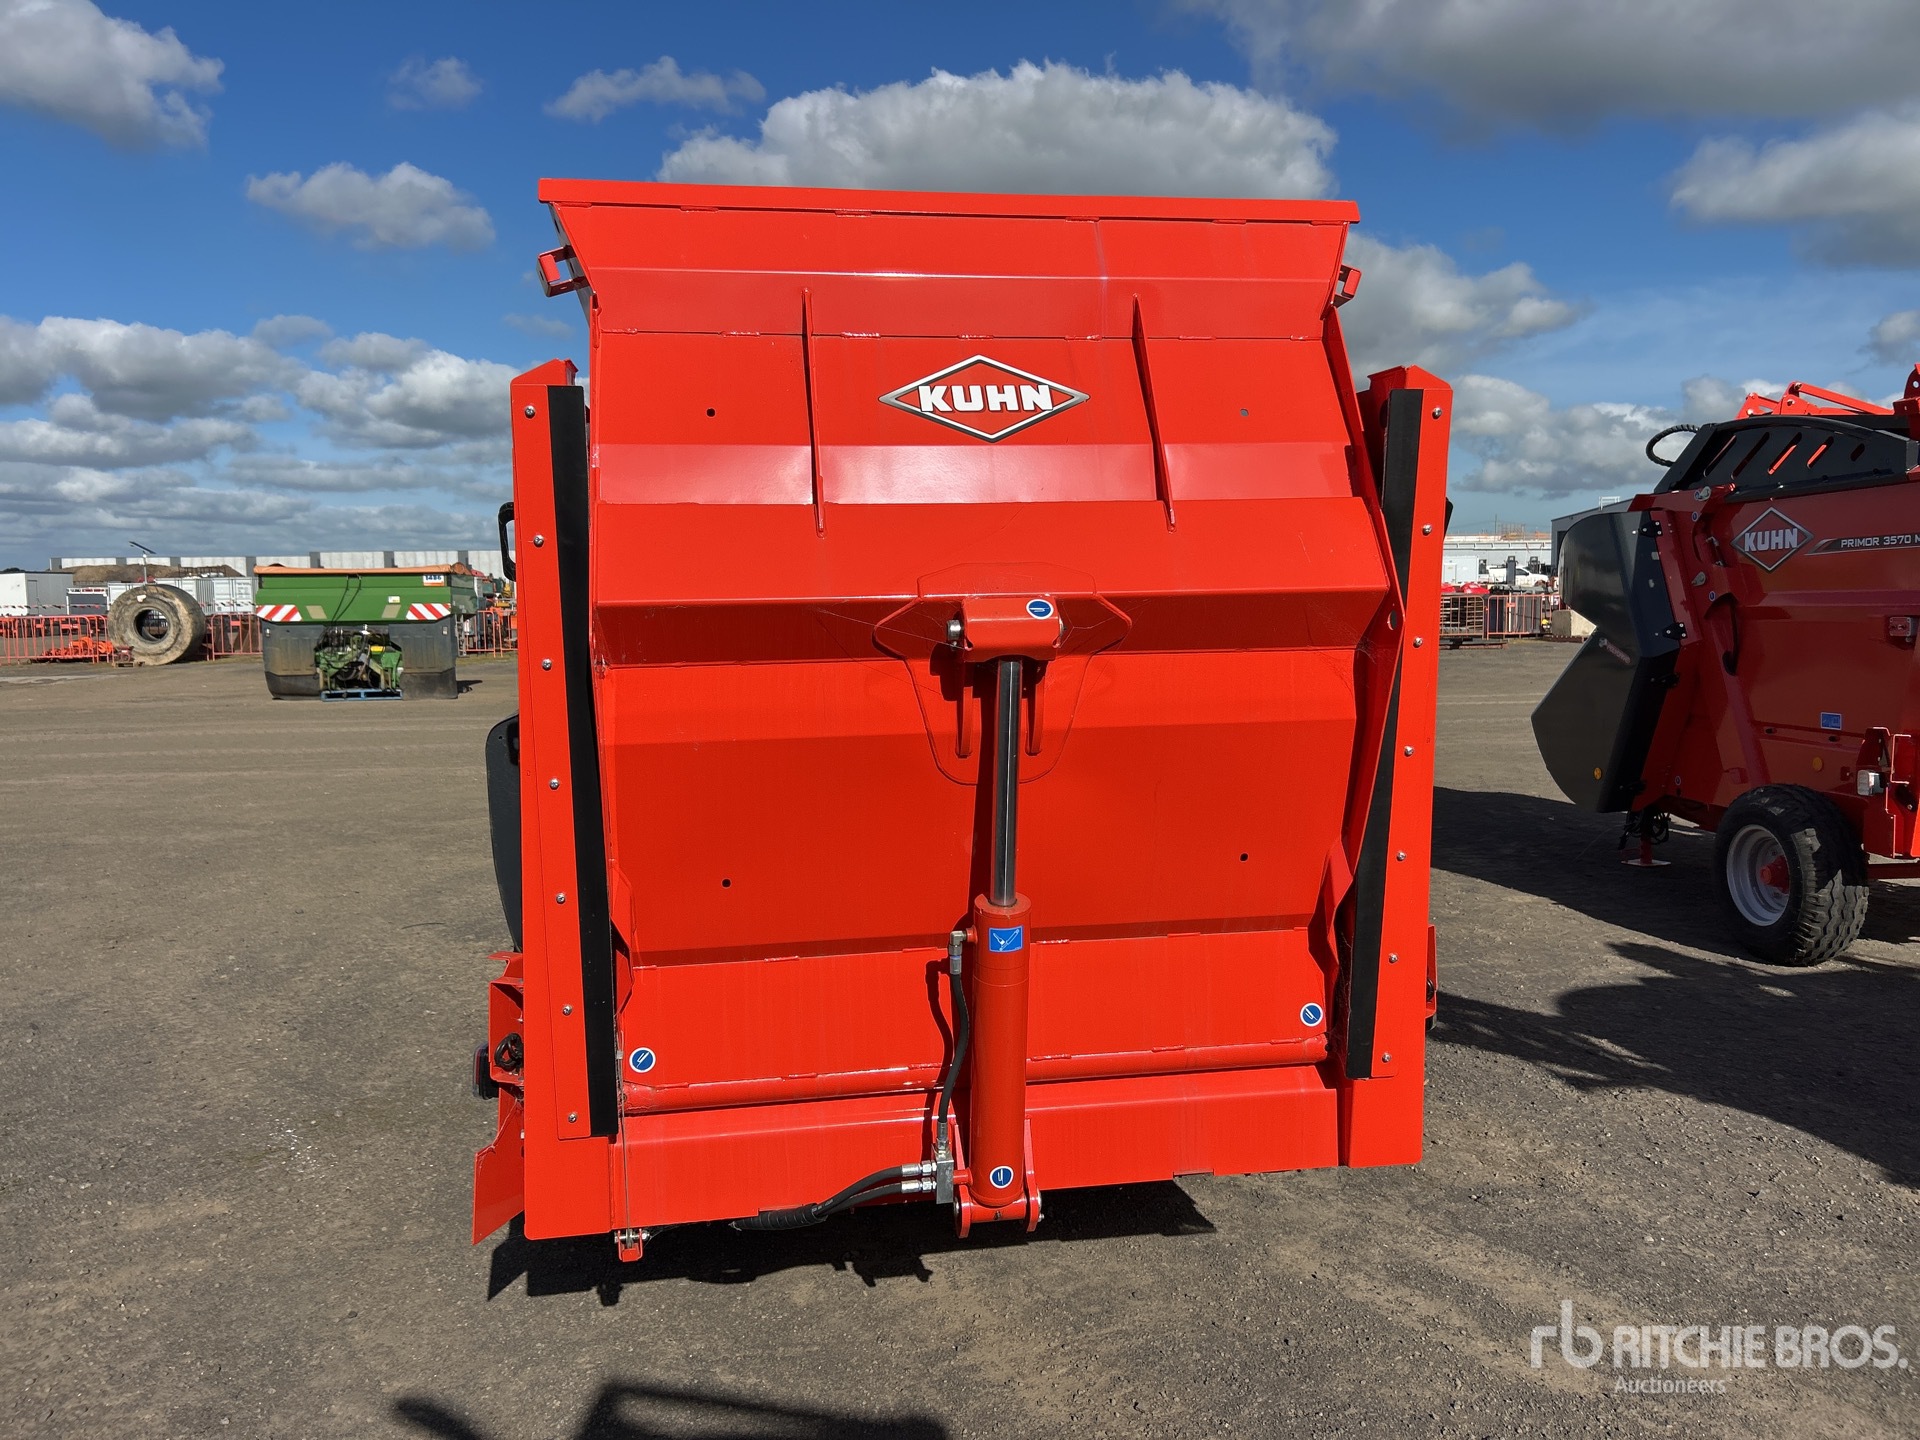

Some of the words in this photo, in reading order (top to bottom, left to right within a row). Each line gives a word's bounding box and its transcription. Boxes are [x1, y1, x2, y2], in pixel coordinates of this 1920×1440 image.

[918, 384, 1053, 412] KUHN
[1744, 528, 1798, 552] KUHN
[1840, 537, 1880, 548] PRIMOR
[1883, 535, 1912, 545] 3570
